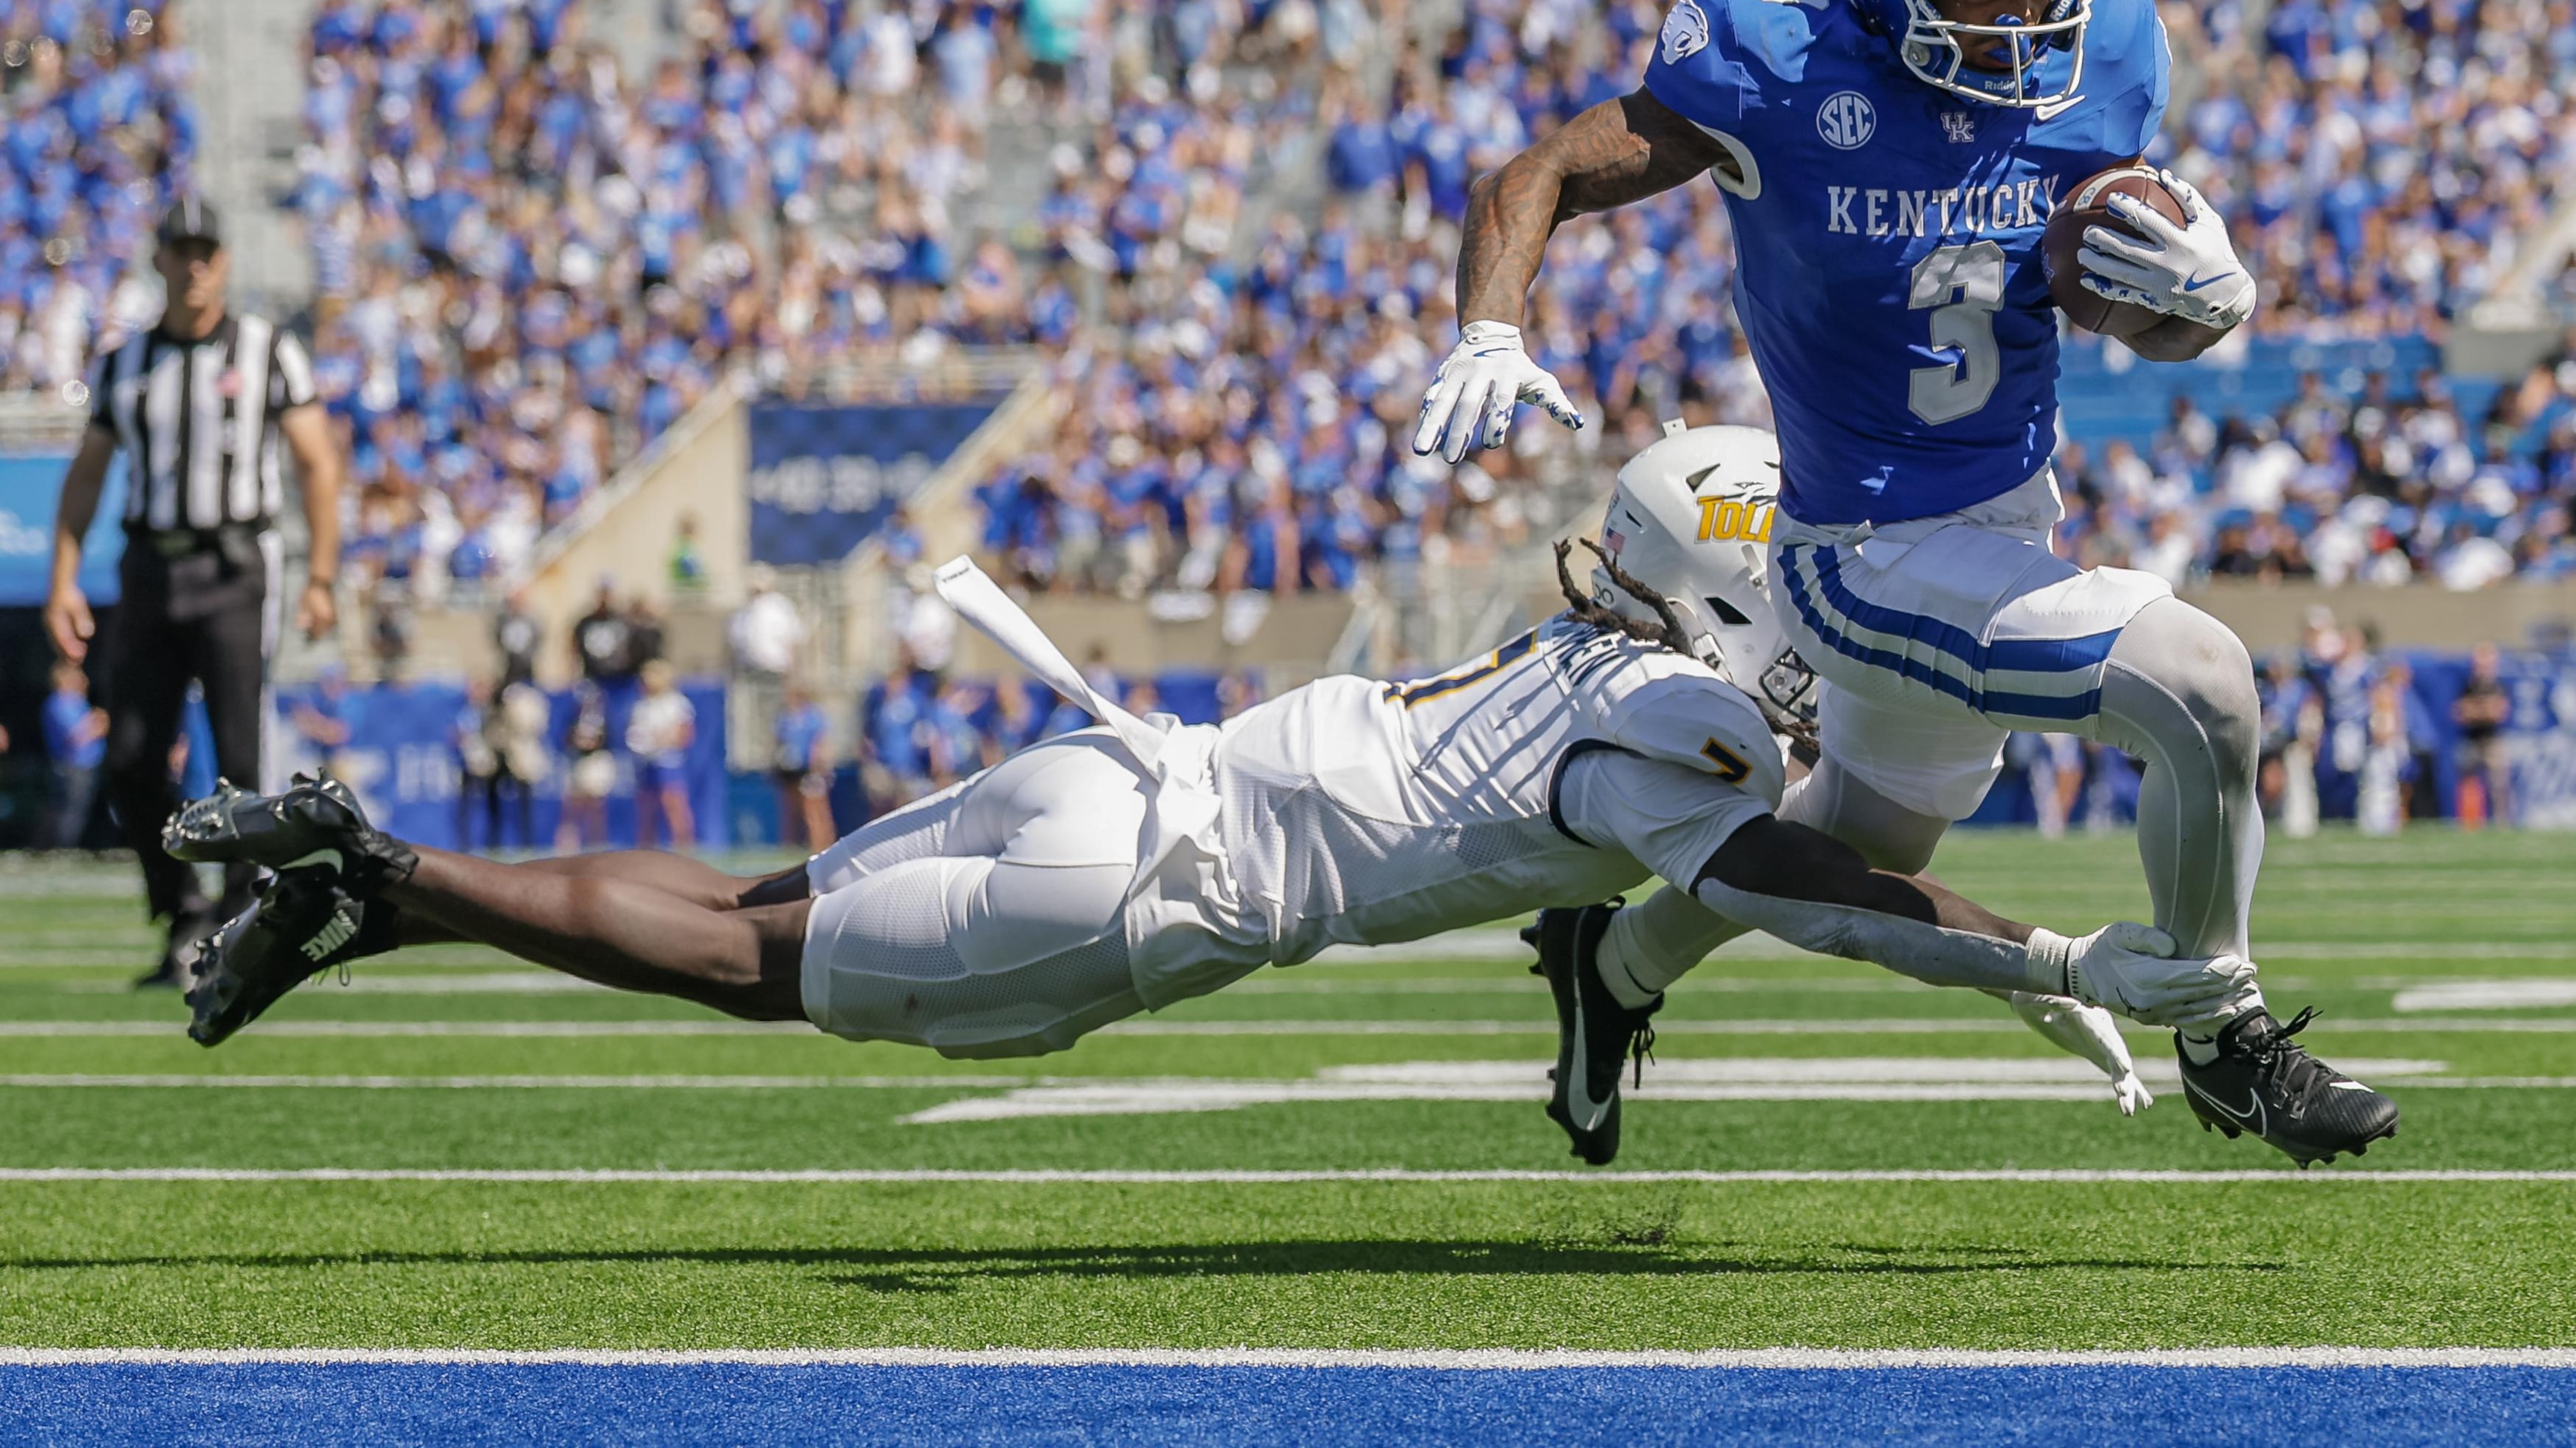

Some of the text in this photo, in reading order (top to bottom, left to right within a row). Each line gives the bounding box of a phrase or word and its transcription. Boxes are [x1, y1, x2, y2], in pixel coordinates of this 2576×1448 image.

[1821, 95, 1872, 146] SEC
[1941, 112, 1974, 142] UK
[1827, 174, 2060, 237] KENTUCKY
[1907, 239, 2006, 427] 3
[1699, 736, 1753, 786] 7
[300, 909, 357, 962] NIKE
